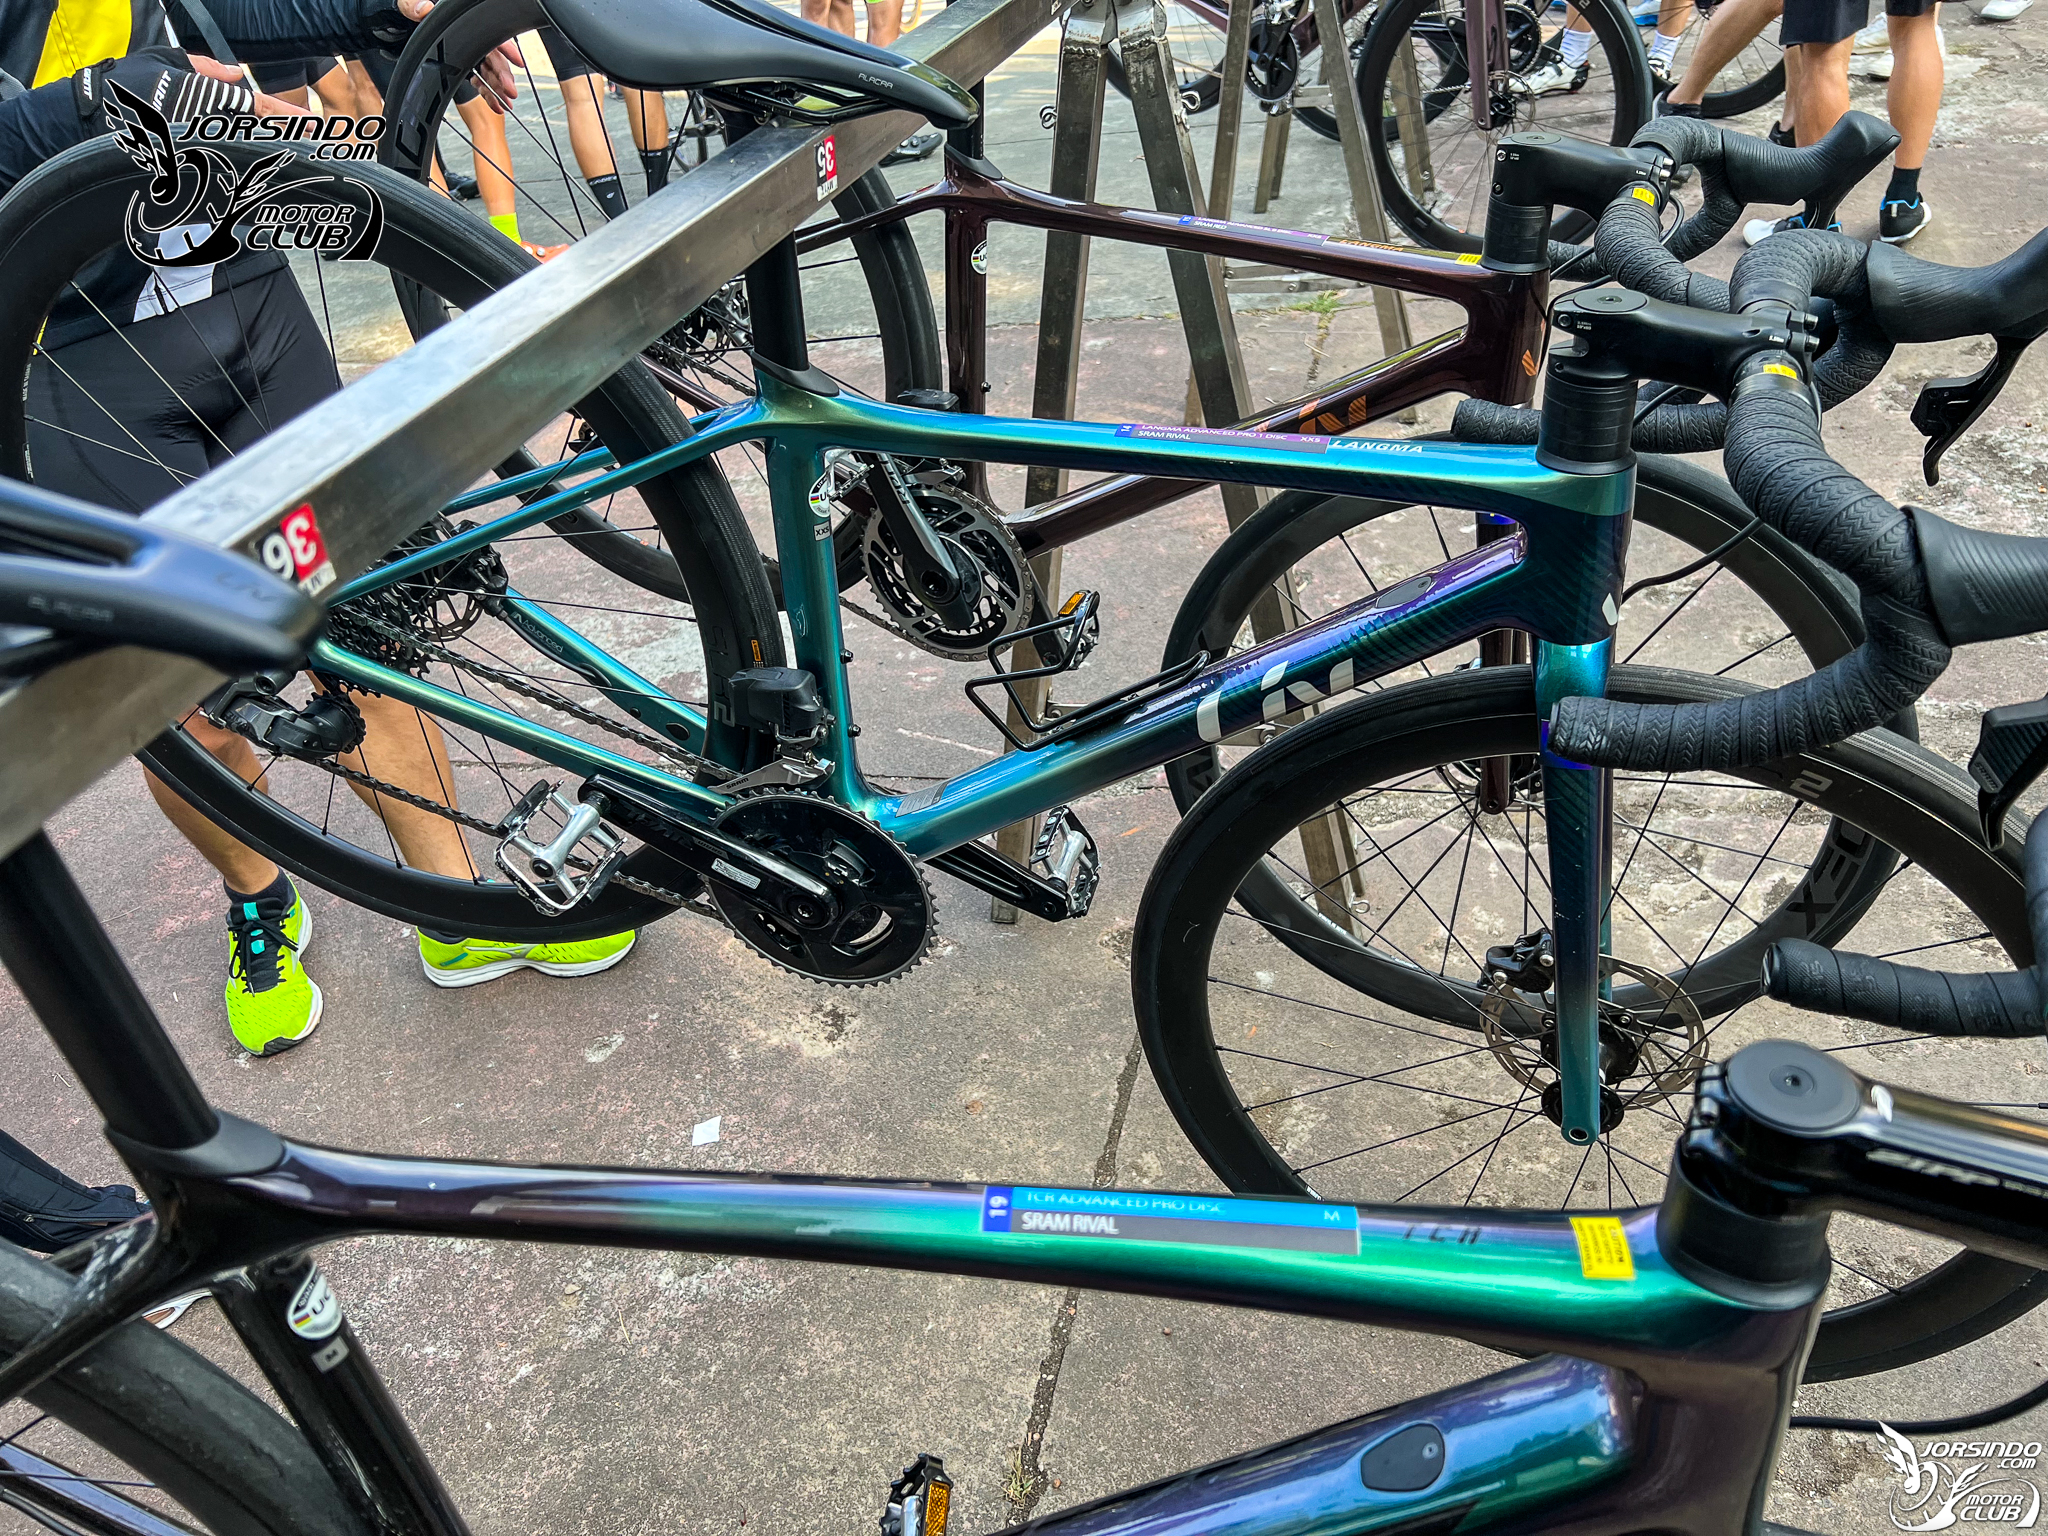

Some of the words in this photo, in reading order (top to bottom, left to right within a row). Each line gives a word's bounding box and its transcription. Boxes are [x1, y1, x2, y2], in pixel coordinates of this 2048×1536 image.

[152, 69, 172, 111] IANT
[1137, 430, 1165, 438] SRAM
[1165, 432, 1191, 440] RIVAL
[1142, 424, 1182, 432] LANGMA
[1184, 427, 1236, 436] ADVANCED
[1332, 440, 1423, 453] LANGMA
[815, 527, 830, 537] XXS
[726, 777, 749, 790] SRAM
[1057, 1192, 1149, 1209] ADVANCED
[1152, 1198, 1187, 1211] PRO
[1189, 1201, 1226, 1214] DISC
[1323, 1209, 1341, 1222] M
[1021, 1211, 1072, 1233] SRAM
[1072, 1215, 1120, 1235] RIVAL
